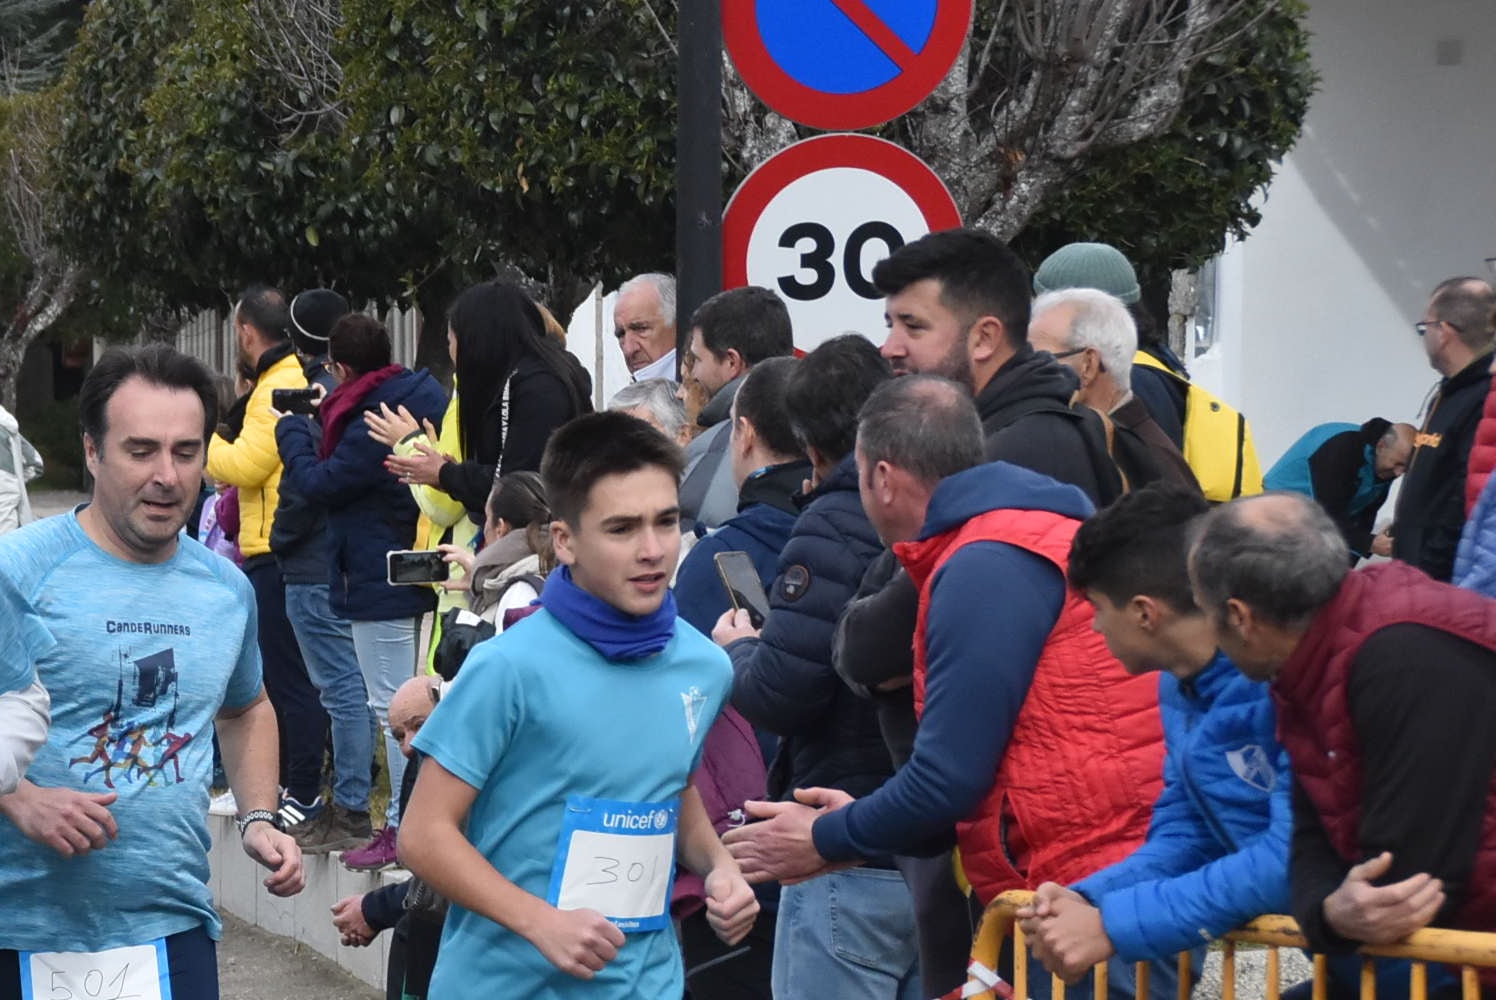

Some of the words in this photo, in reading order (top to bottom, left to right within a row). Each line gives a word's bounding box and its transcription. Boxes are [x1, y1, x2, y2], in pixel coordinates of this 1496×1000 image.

[776, 220, 906, 301] 30
[603, 810, 655, 829] unicef
[585, 855, 658, 885] 301
